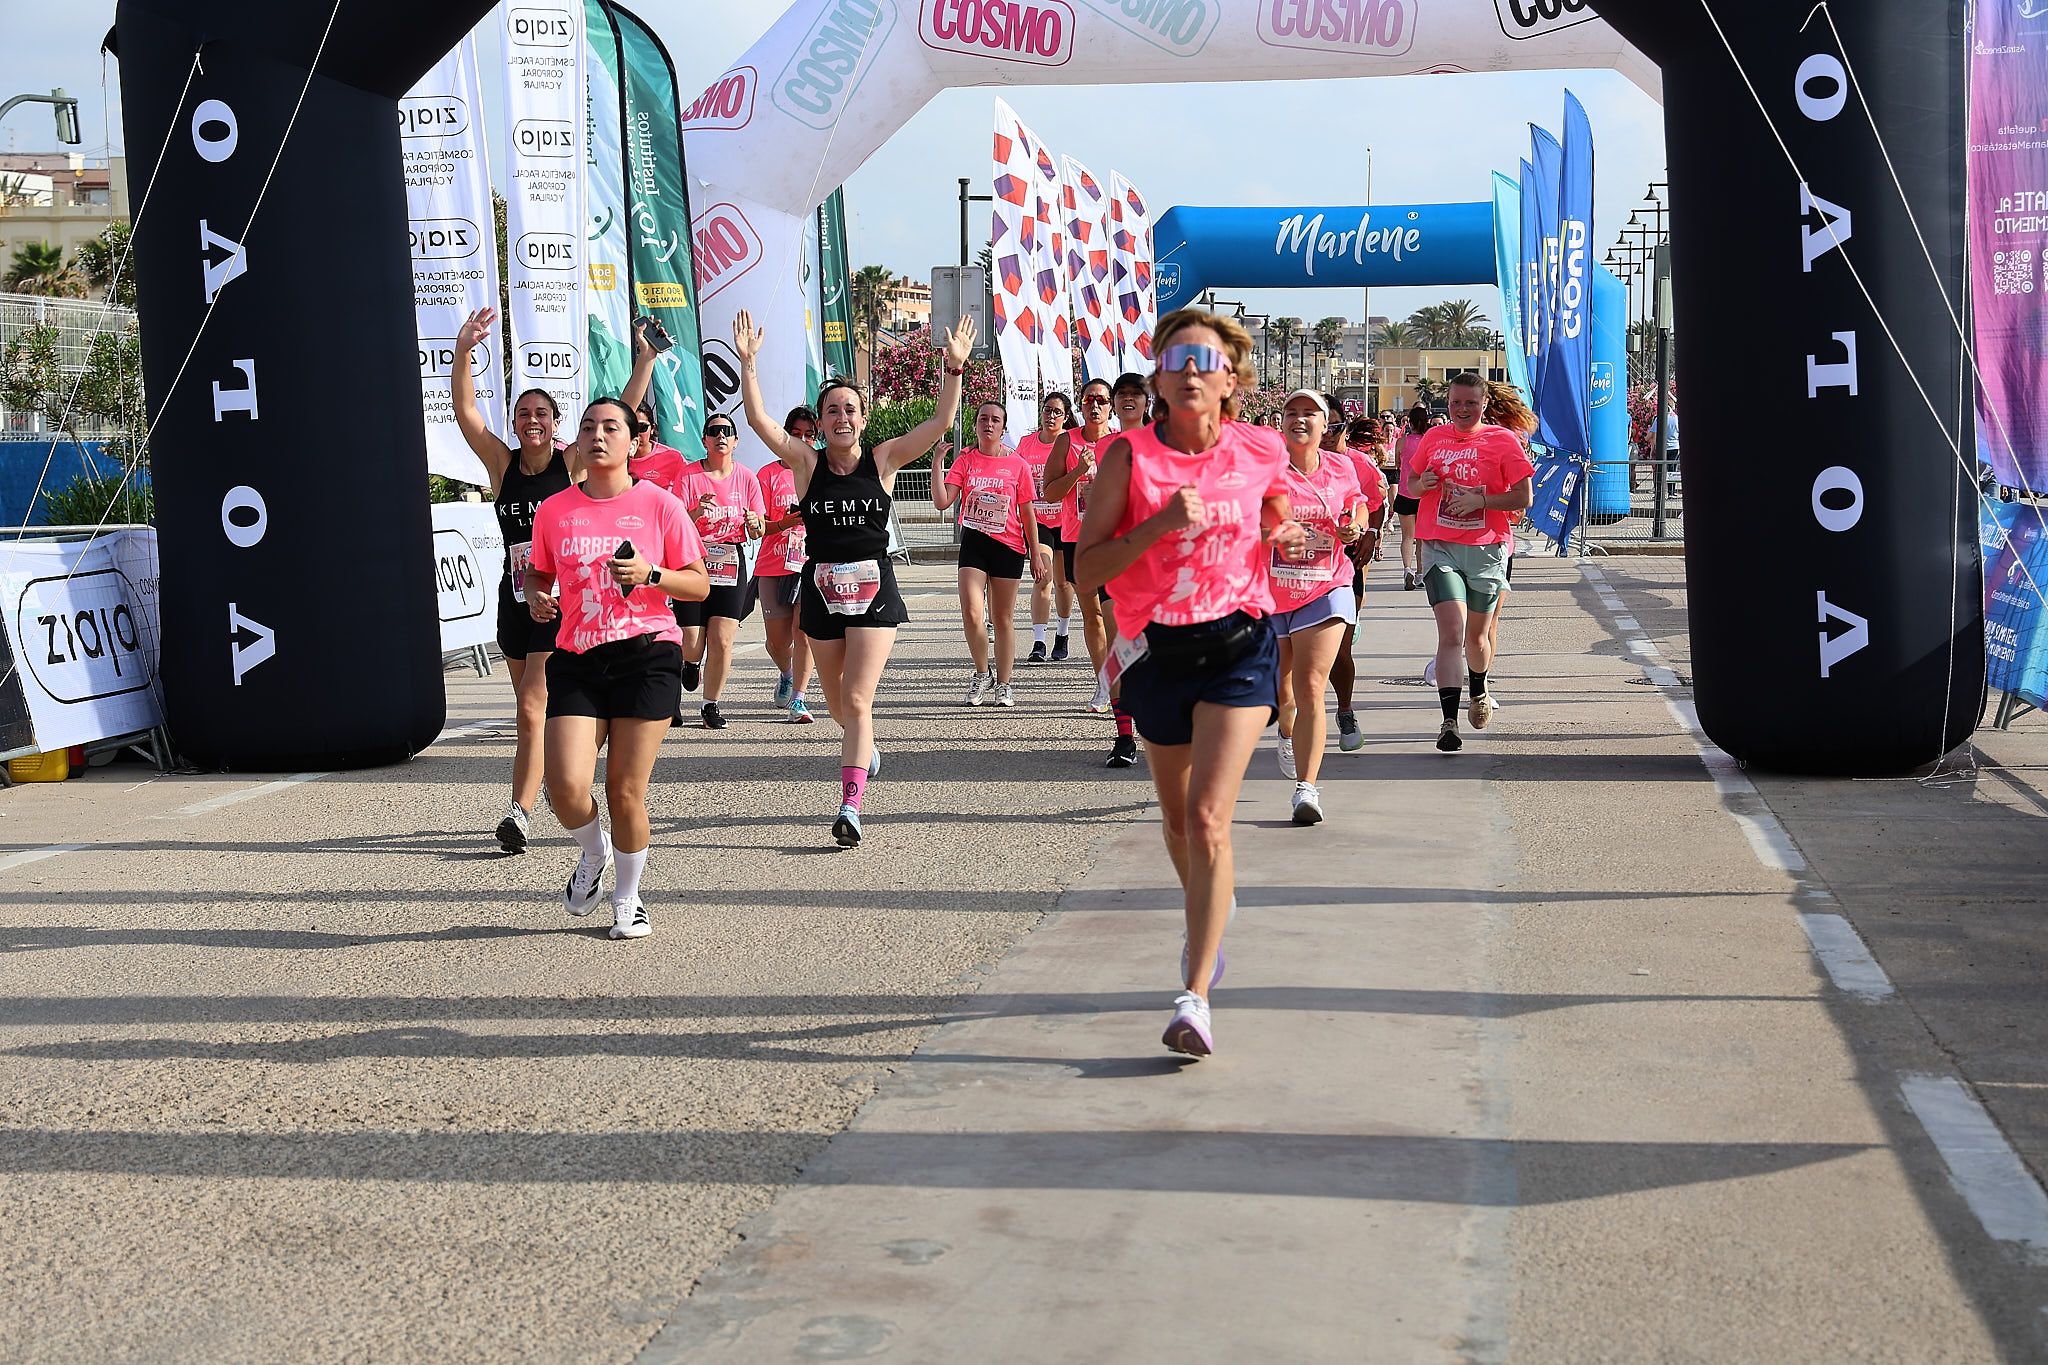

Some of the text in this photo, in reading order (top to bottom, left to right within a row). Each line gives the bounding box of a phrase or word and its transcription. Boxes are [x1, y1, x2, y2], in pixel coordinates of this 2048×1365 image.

[933, 0, 1062, 57] COSMO
[1272, 0, 1404, 48] COSMO
[1795, 54, 1869, 678] VOLVO
[1590, 373, 1611, 391] lene
[192, 100, 275, 686] VOLVO
[1434, 448, 1478, 460] CARRERA
[967, 477, 1004, 489] CARRERA
[810, 498, 883, 515] KEMYL
[978, 508, 994, 518] 016
[833, 515, 866, 526] LIFE
[561, 536, 632, 557] CARRER
[1302, 550, 1315, 559] 16
[706, 562, 724, 570] 016
[435, 554, 475, 606] iaja
[835, 582, 860, 594] 016
[37, 603, 140, 677] ziaja
